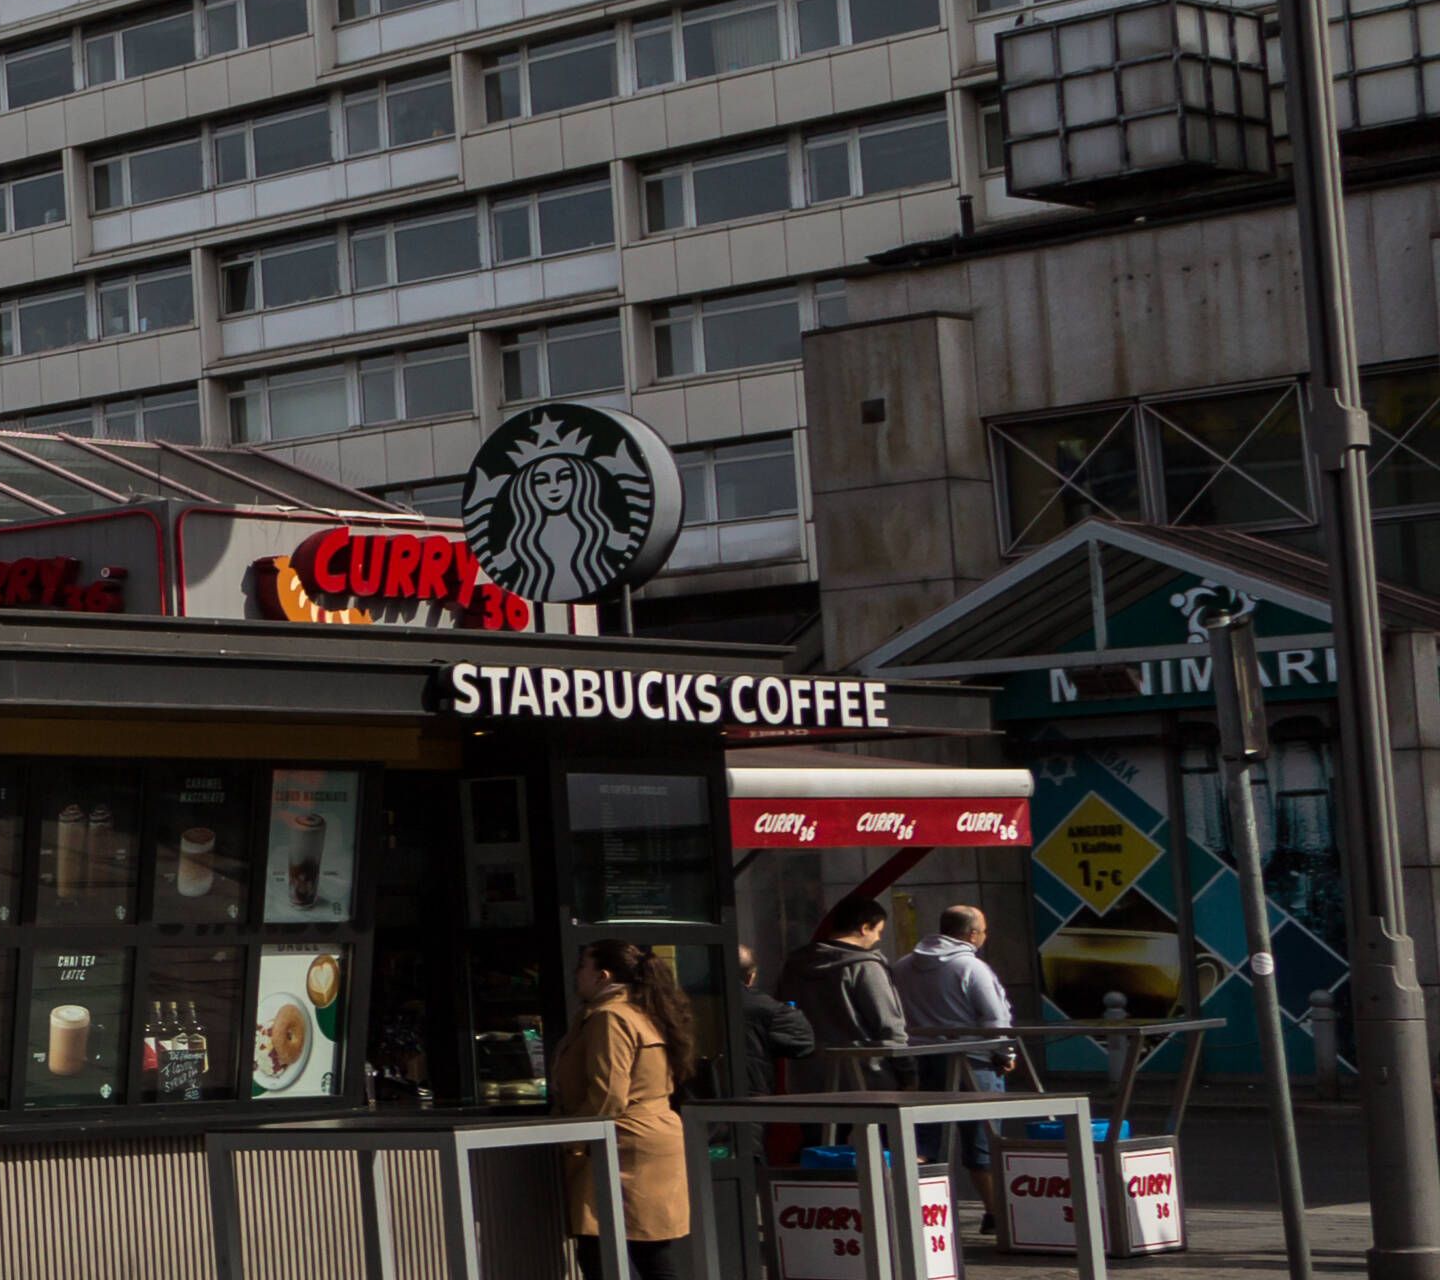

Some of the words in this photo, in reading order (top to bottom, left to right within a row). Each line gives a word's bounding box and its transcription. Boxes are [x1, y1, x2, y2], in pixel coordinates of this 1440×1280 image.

[312, 526, 481, 608] CURRY
[452, 663, 722, 723] STARBUCKS
[730, 676, 889, 727] COFFEE
[754, 812, 806, 834] CURRY
[799, 825, 816, 841] 36
[856, 812, 904, 833] CURRY
[897, 825, 914, 840] 36
[956, 812, 1003, 834] CURRY
[1000, 825, 1018, 840] 36
[57, 955, 78, 967] CHAI
[61, 969, 86, 981] LATTE
[1011, 1175, 1072, 1198] CURR
[1128, 1173, 1172, 1198] CURRY
[922, 1204, 947, 1227] RRY
[1156, 1203, 1170, 1219] 36
[833, 1238, 860, 1256] 36
[931, 1235, 945, 1252] 36
